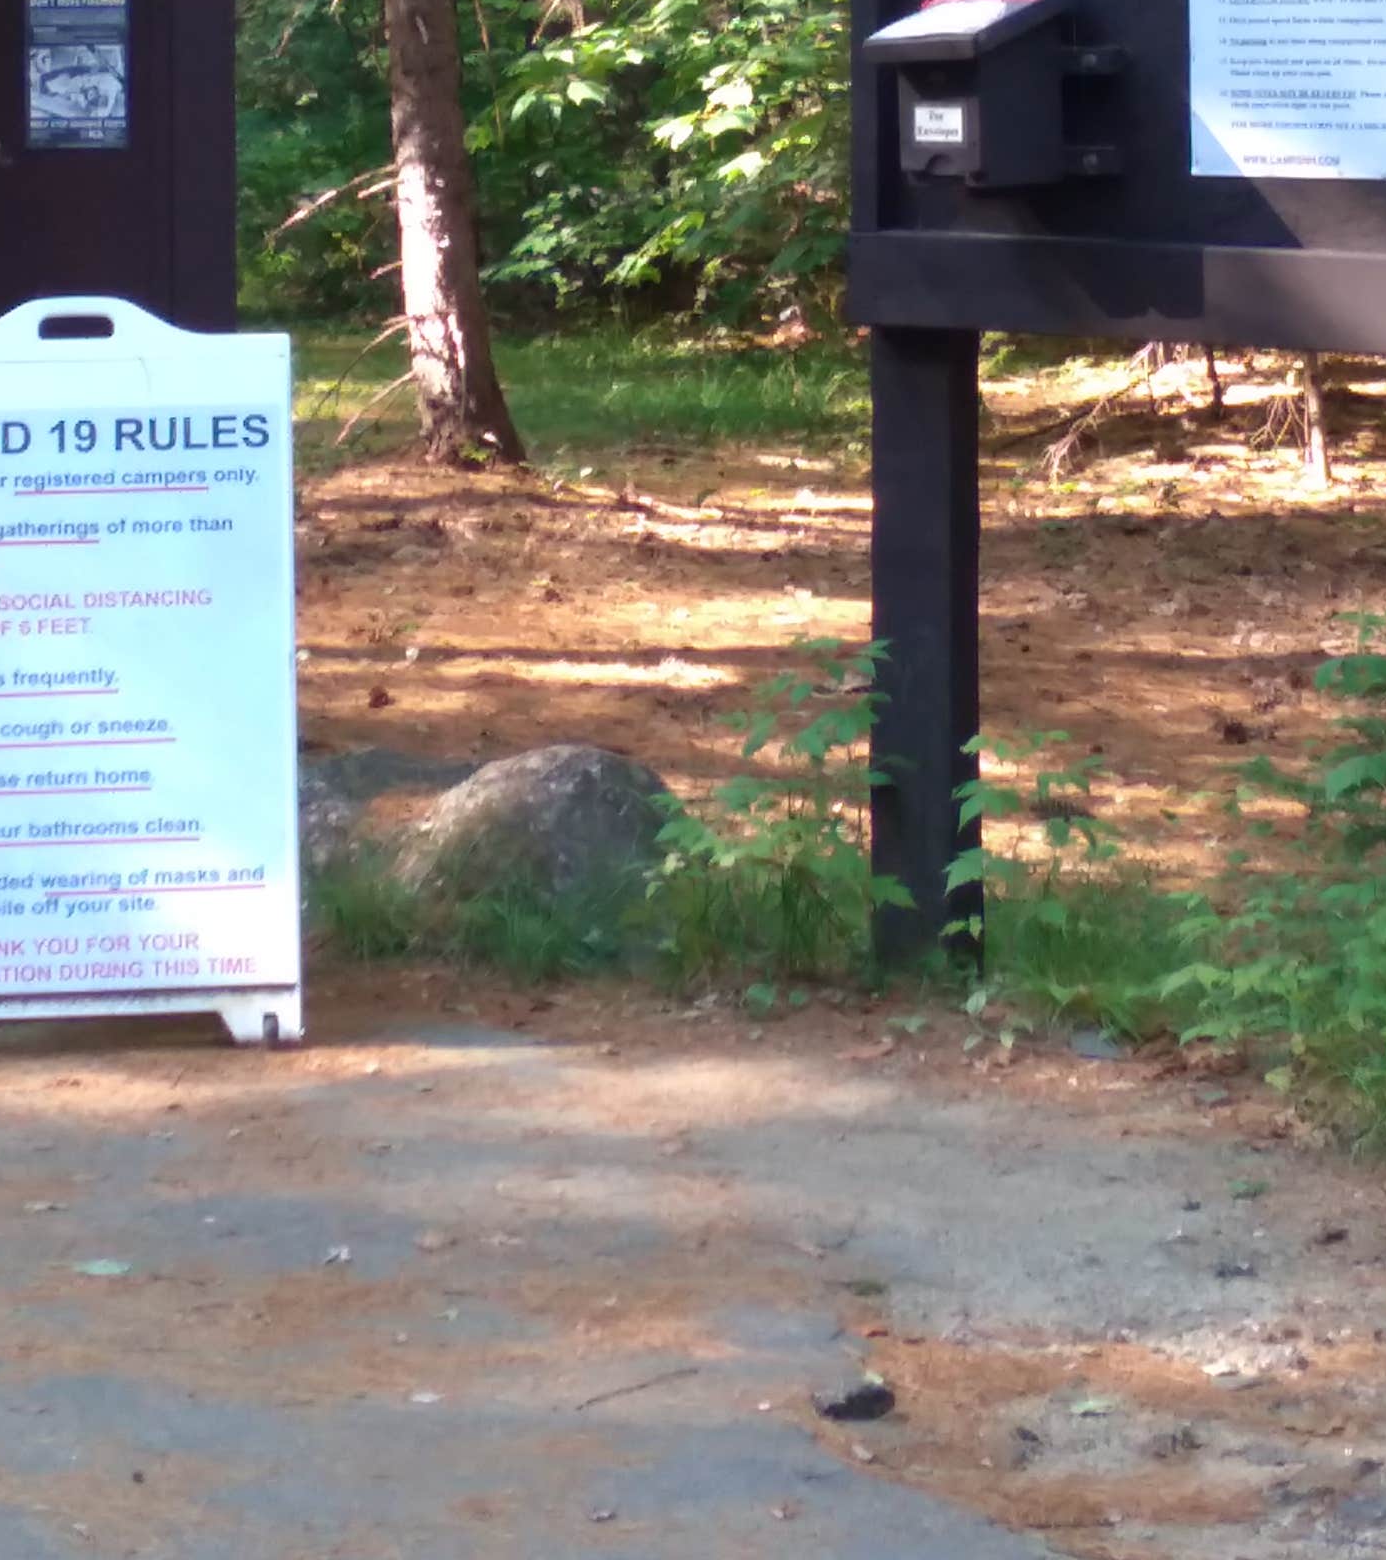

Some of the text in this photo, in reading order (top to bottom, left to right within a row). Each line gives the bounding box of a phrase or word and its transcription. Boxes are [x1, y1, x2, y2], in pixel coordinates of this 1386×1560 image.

[50, 418, 96, 454] 19
[115, 414, 269, 452] RULES
[13, 470, 115, 493] registered
[121, 473, 207, 490] campers
[106, 520, 126, 535] of
[132, 522, 182, 534] more
[189, 517, 232, 532] than
[83, 590, 212, 609] DISTANCING
[0, 720, 63, 741] cough
[70, 723, 91, 735] or
[26, 771, 87, 787] return
[28, 820, 138, 838] bathrooms
[40, 870, 121, 892] wearing
[127, 869, 149, 885] of
[154, 867, 219, 884] masks
[227, 866, 265, 882] and
[31, 900, 59, 915] off
[65, 901, 111, 918] your
[33, 938, 78, 955] YOU
[86, 936, 130, 953] FOR
[139, 934, 198, 952] YOUR
[59, 961, 143, 980] DURING
[154, 959, 199, 977] THIS
